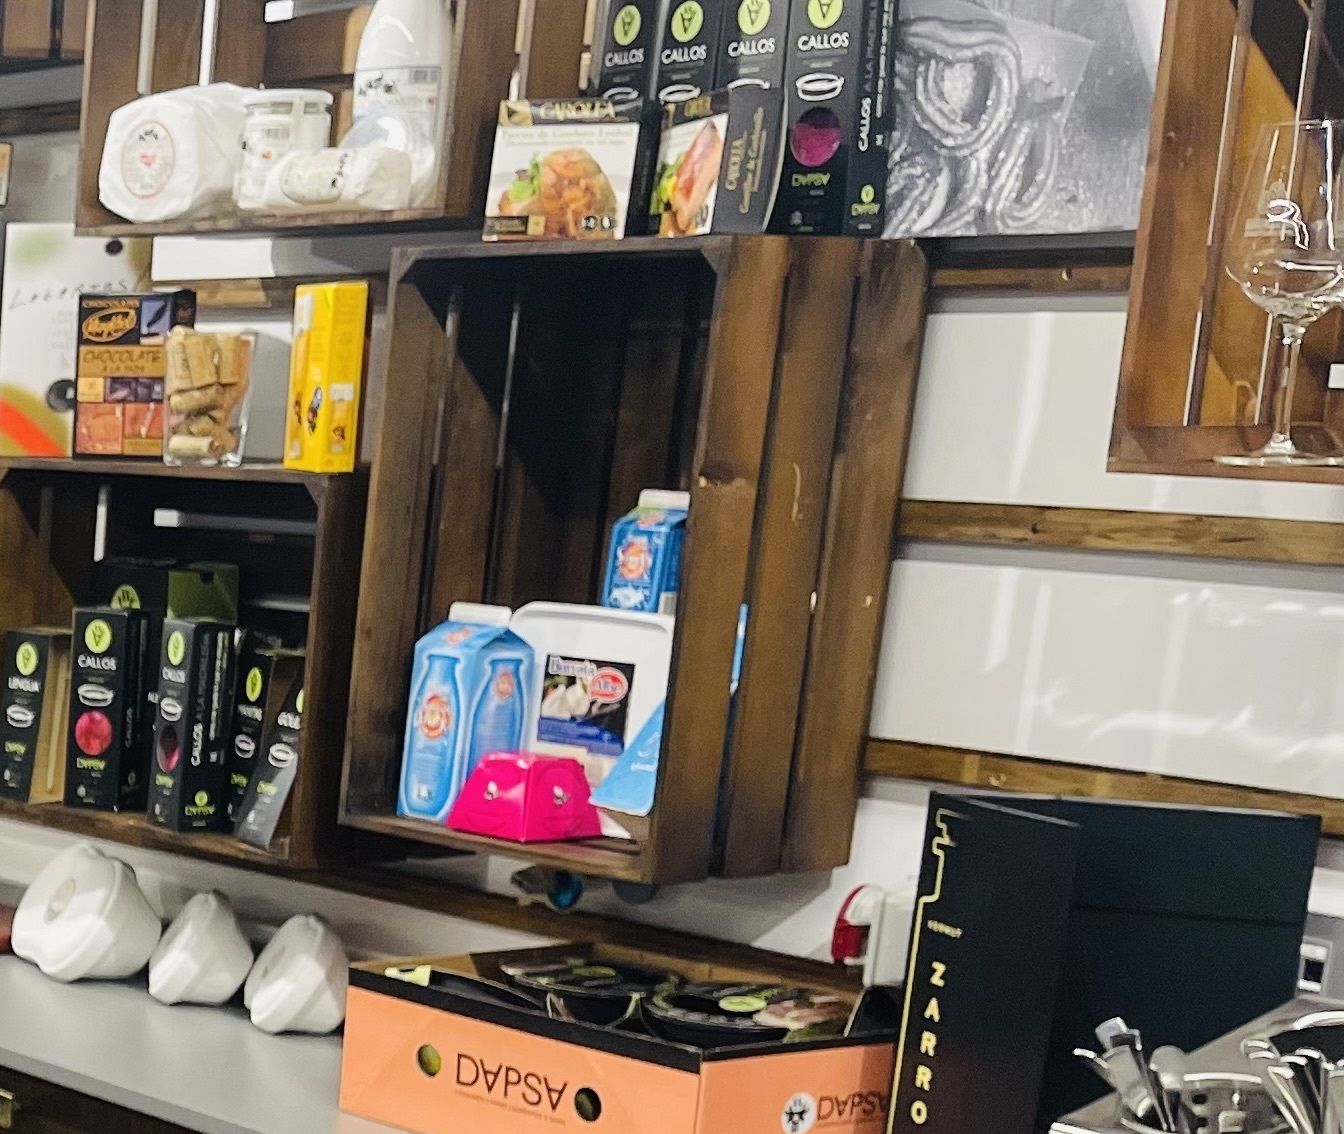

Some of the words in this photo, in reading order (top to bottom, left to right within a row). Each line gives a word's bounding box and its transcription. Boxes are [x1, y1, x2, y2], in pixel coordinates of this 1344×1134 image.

[728, 38, 776, 57] CALLOS
[797, 32, 850, 51] CALLOS
[661, 45, 707, 64] CALLOS
[78, 654, 117, 671] CALLOS
[910, 960, 947, 1125] ZARRO
